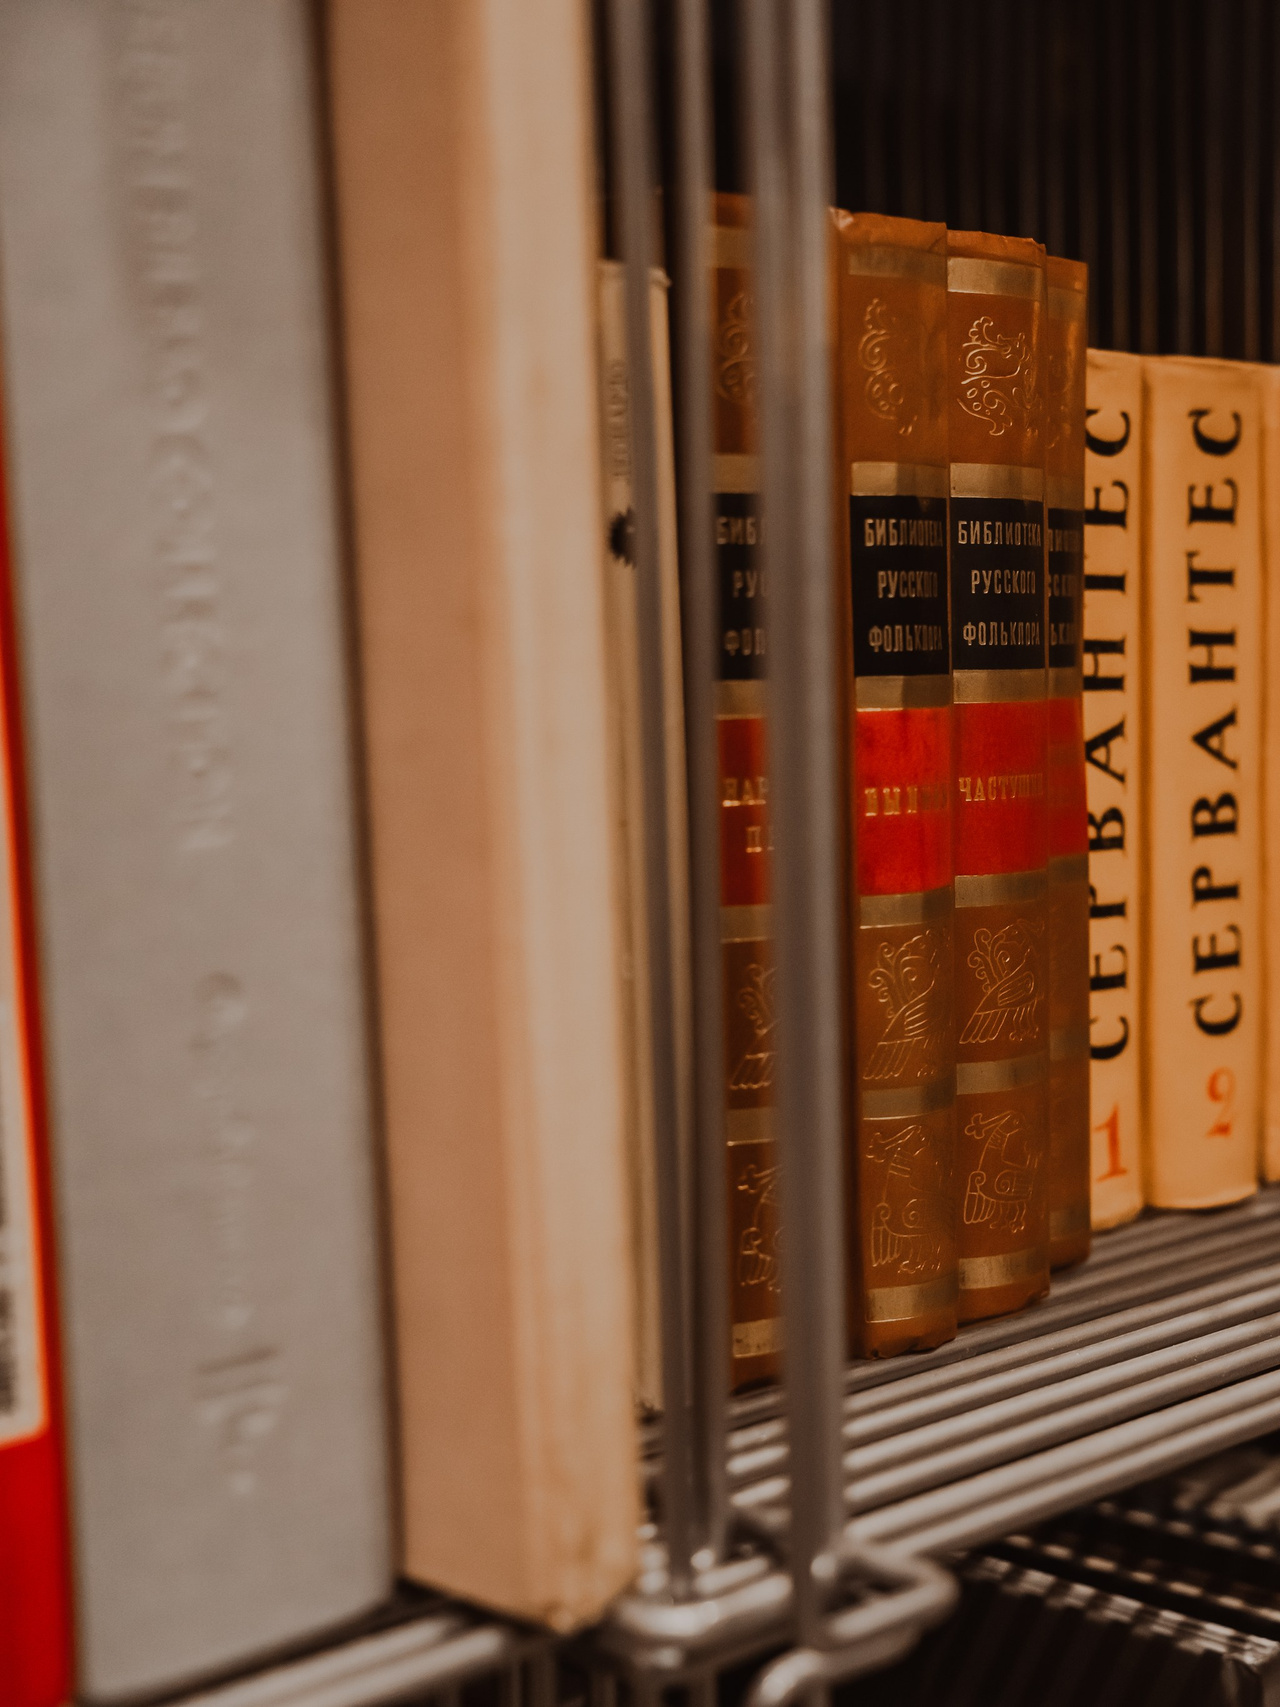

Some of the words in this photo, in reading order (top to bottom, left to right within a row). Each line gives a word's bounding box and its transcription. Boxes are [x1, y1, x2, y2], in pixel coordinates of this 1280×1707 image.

[863, 518, 944, 548] БИБЛИОТЕКА
[957, 519, 1042, 548] БИБЛИОТЕКА
[970, 568, 1037, 595] РУССКОГО
[962, 620, 1041, 647] ФОЛЬКЛОРА
[1186, 408, 1243, 1037] СЕРВАНТЕС
[1206, 1066, 1237, 1139] 2
[1094, 1103, 1129, 1183] 1
